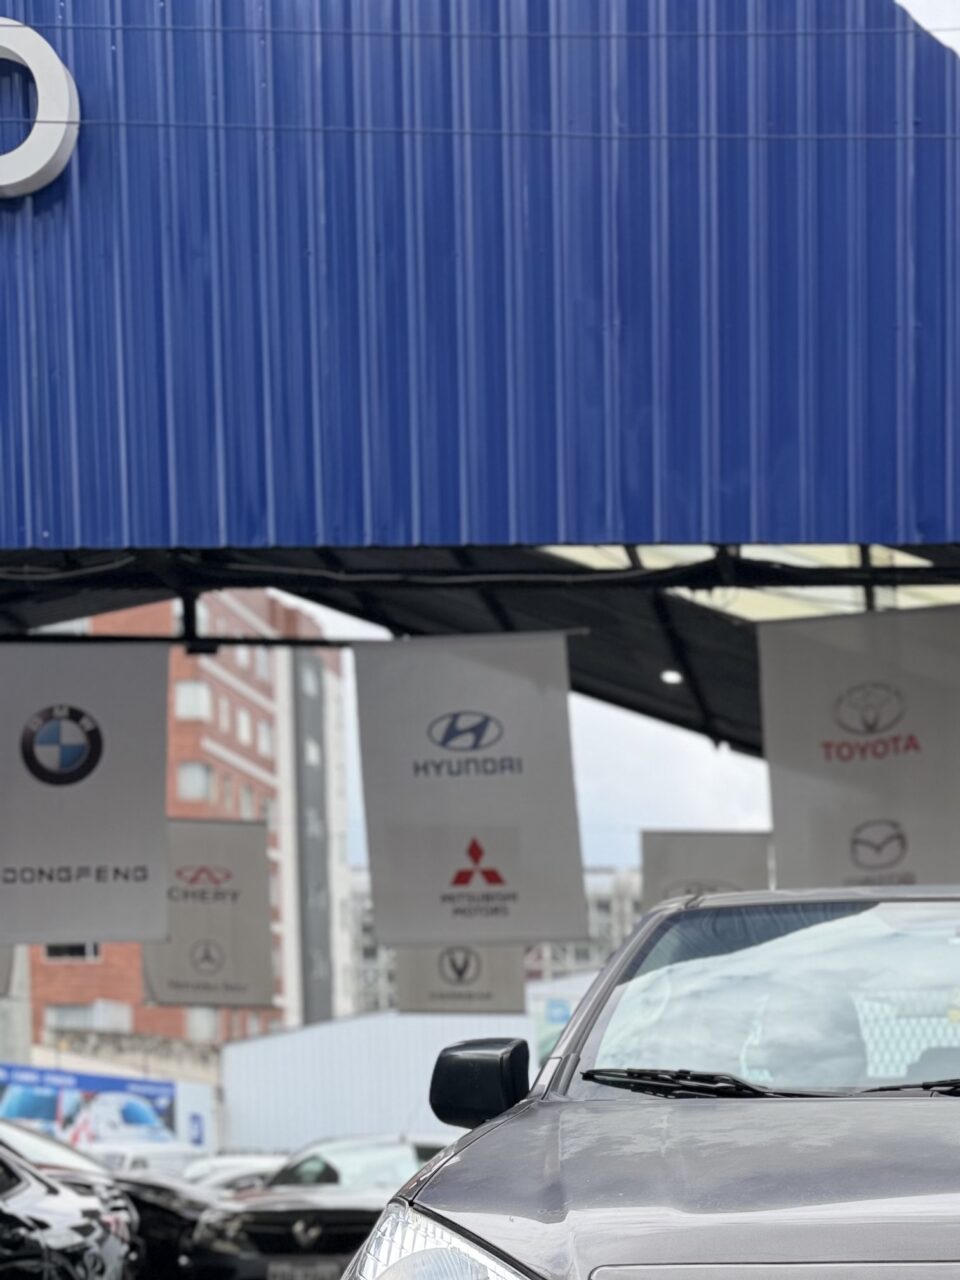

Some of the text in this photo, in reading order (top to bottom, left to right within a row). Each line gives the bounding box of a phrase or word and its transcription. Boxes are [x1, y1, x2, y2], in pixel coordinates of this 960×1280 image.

[821, 732, 921, 763] TOYOTA
[413, 756, 523, 778] HYUNDAI
[2, 865, 148, 885] DONGFENG
